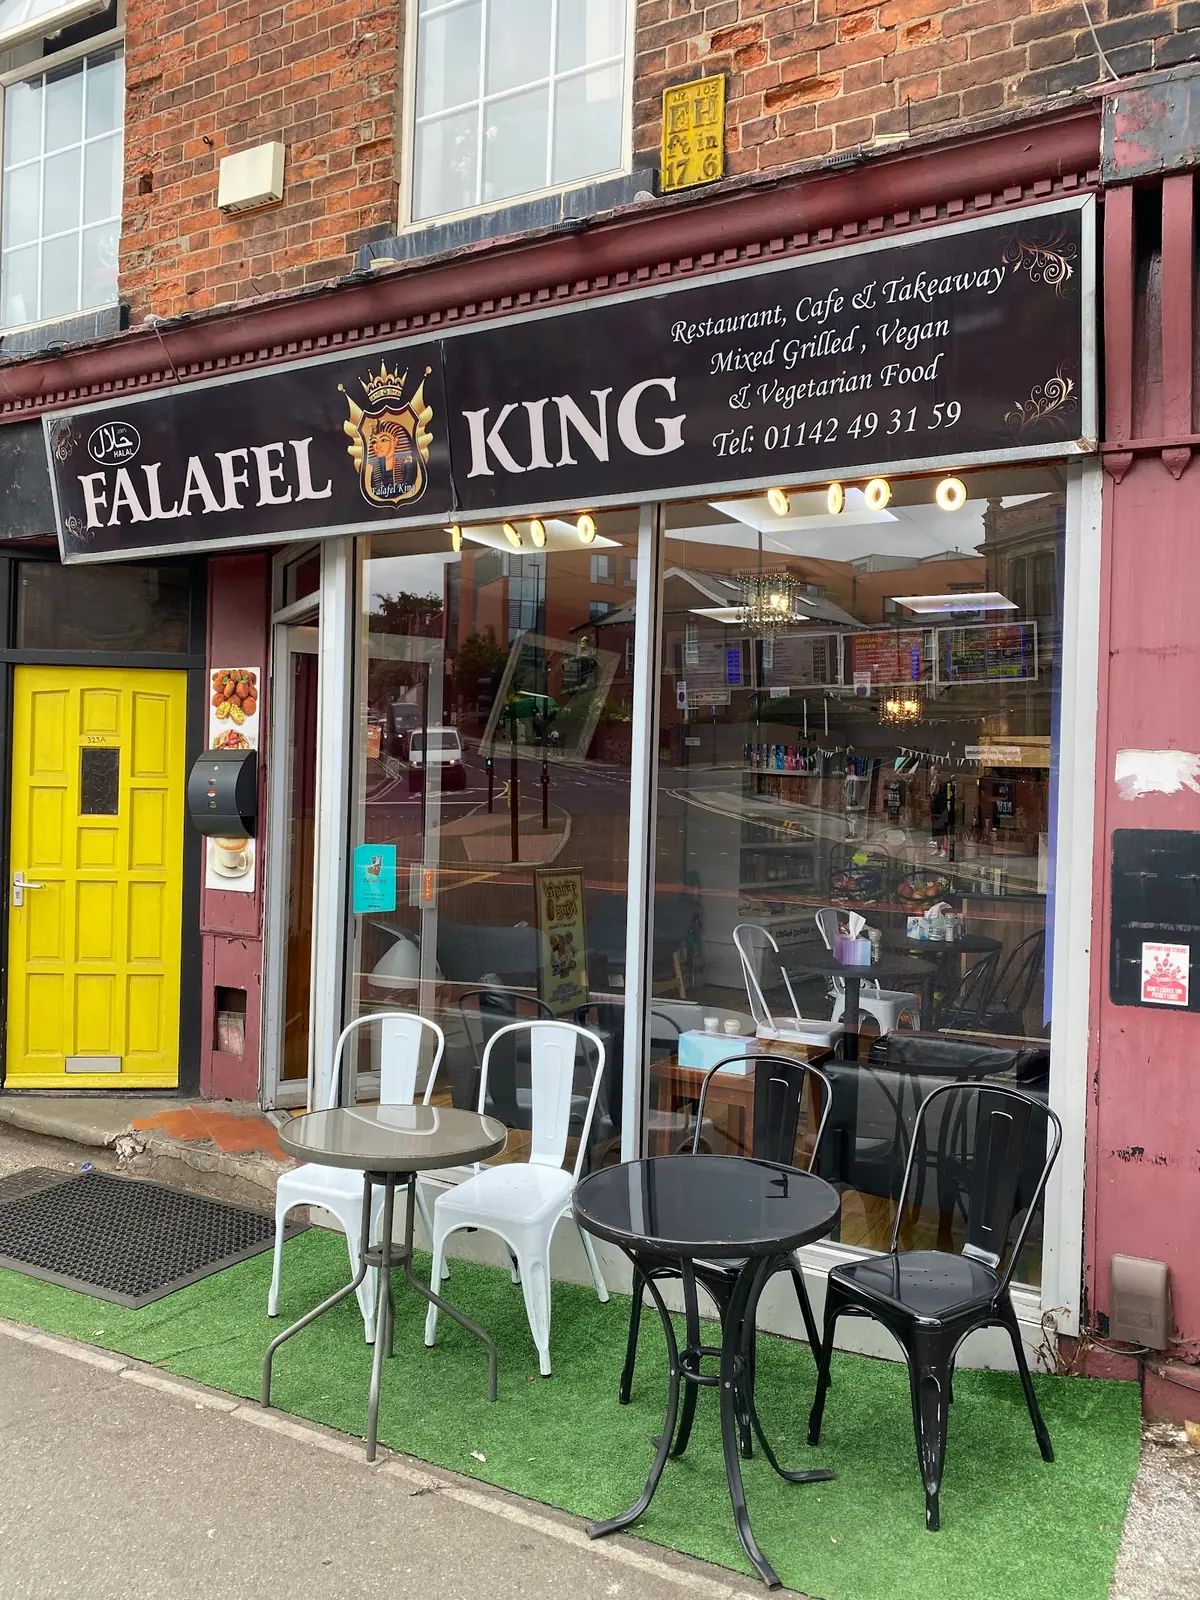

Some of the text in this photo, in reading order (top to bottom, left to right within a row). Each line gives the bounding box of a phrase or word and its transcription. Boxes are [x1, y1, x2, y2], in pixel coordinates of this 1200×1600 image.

[697, 134, 718, 151] in
[666, 158, 690, 187] 17
[671, 266, 1006, 344] Restaurant, Cafe & Takeaway
[710, 340, 776, 375] Mixed
[783, 325, 857, 371] Grilled
[876, 317, 950, 351] Vegan
[728, 353, 945, 410] & Vegetarian Food
[94, 426, 133, 458] حلال
[461, 376, 687, 479] KING
[712, 401, 963, 457] Tel: 01142 49 31 59
[113, 448, 134, 458] HALAL
[77, 437, 333, 531] FALAFEL
[372, 483, 416, 497] Falafel King
[87, 736, 107, 744] 323A
